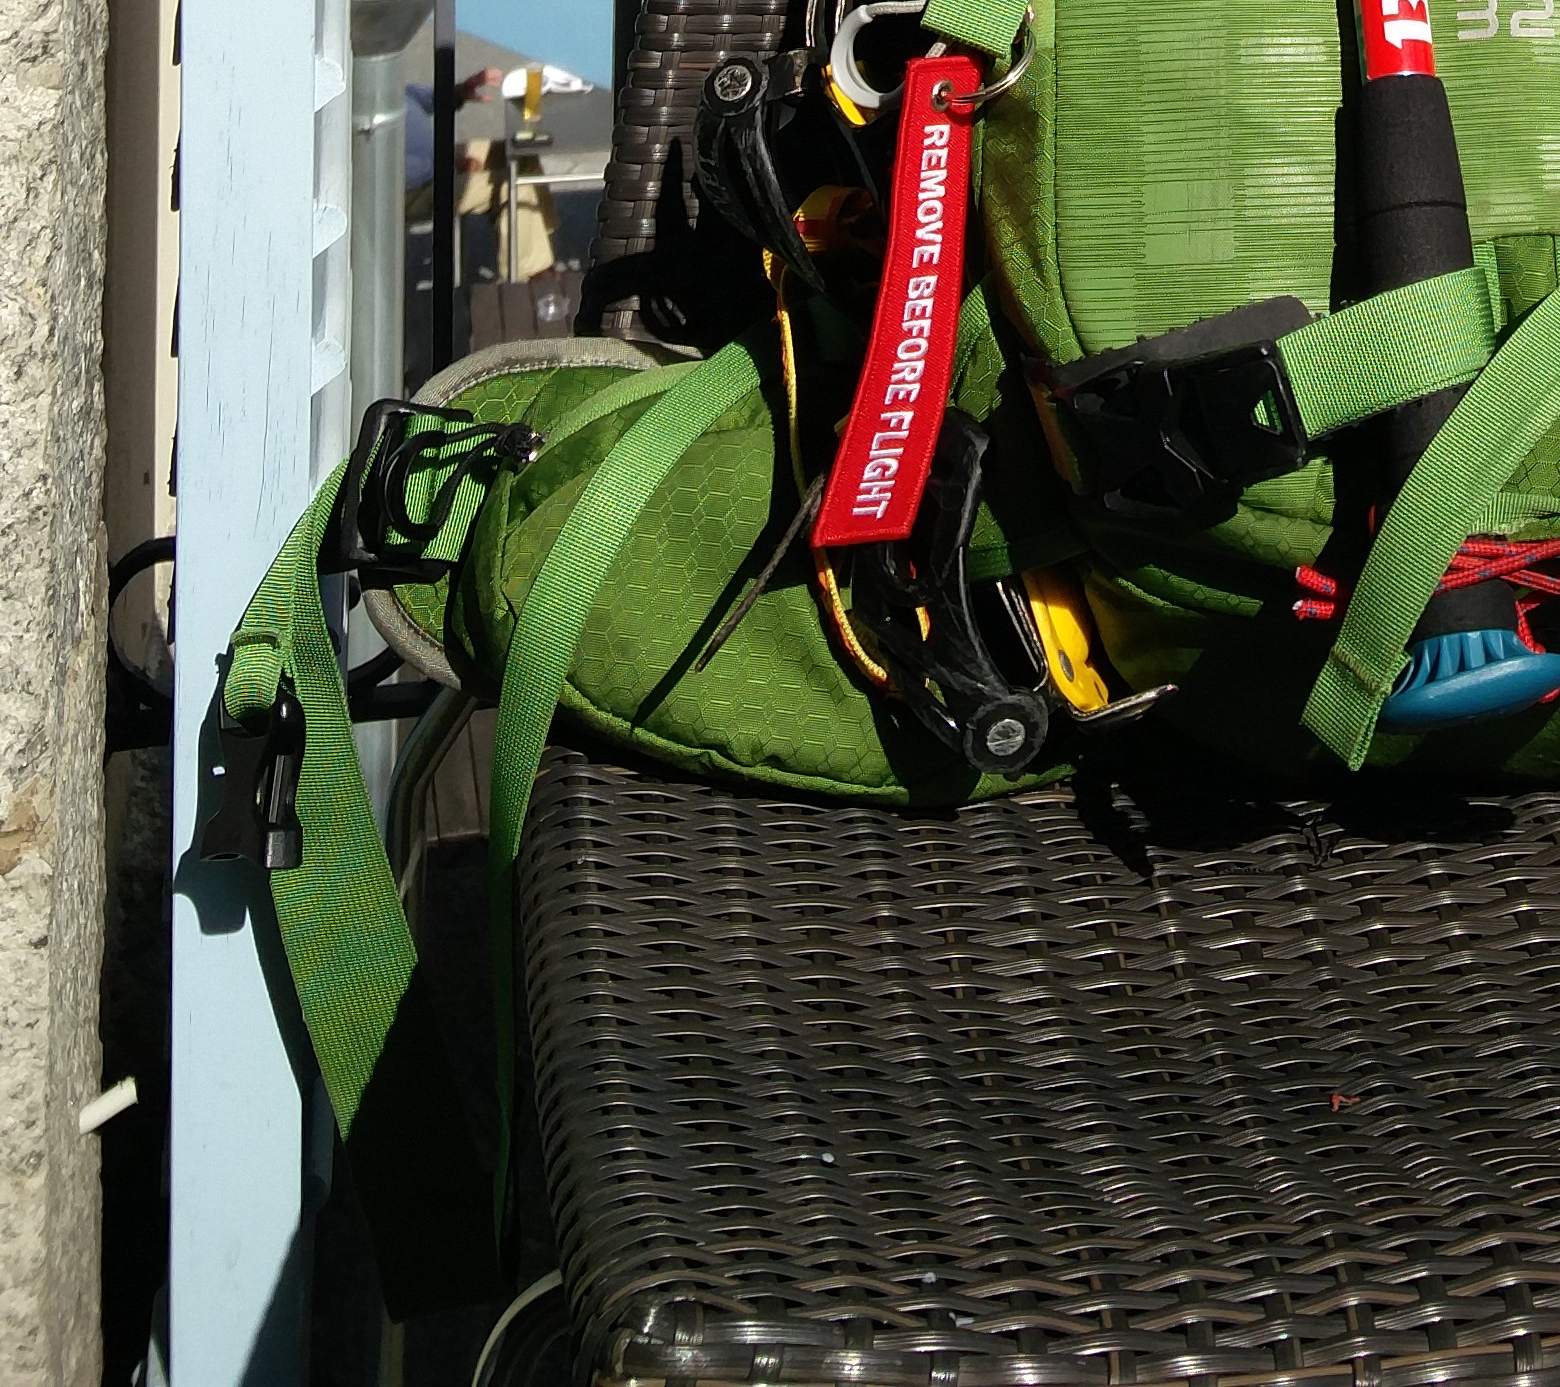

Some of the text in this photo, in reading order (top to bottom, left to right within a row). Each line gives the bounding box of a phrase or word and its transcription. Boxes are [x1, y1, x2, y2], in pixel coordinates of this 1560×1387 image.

[852, 124, 951, 520] REMOVE BEFORE FLIGHT
